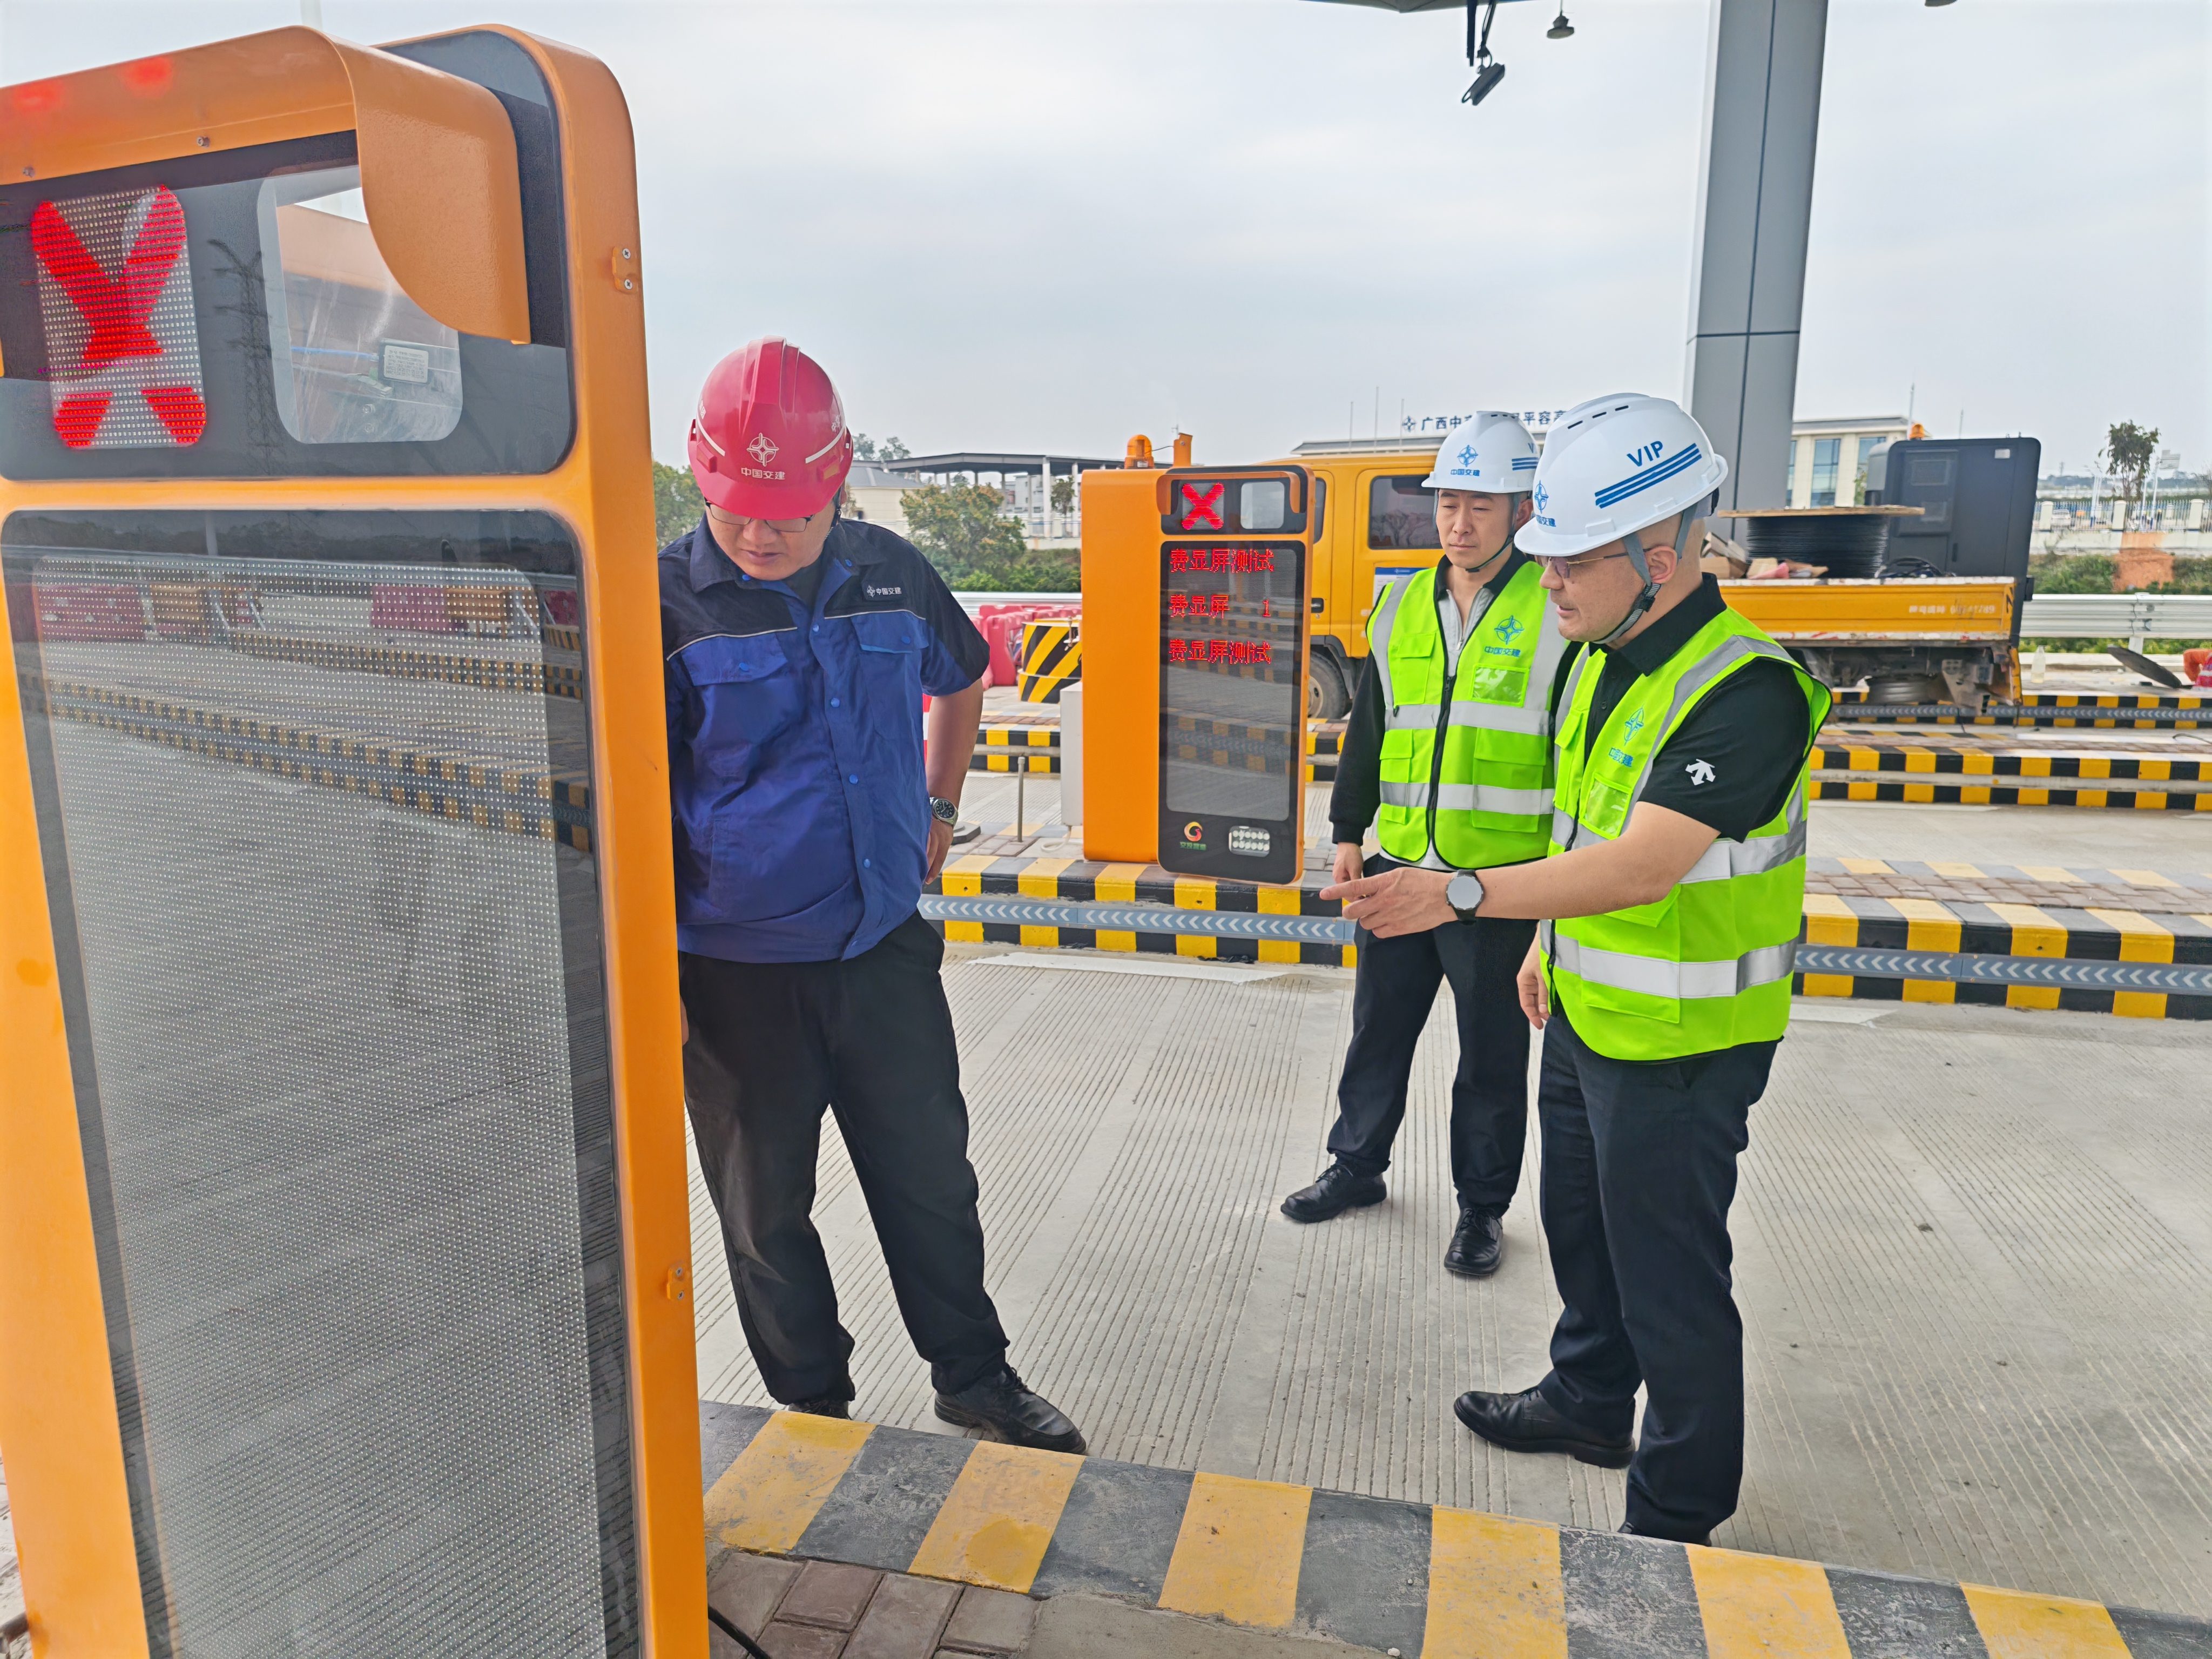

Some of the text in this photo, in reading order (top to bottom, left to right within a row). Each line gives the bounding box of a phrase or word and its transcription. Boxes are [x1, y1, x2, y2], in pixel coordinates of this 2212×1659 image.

[1627, 441, 1663, 467] VIP
[741, 467, 785, 480] 中国交建
[1170, 548, 1274, 573] 费显屏测试
[876, 587, 902, 595] 中国交建
[1169, 594, 1230, 619] 费显屏
[1169, 639, 1271, 664] 费显屏测试
[1485, 646, 1520, 657] 中国交建
